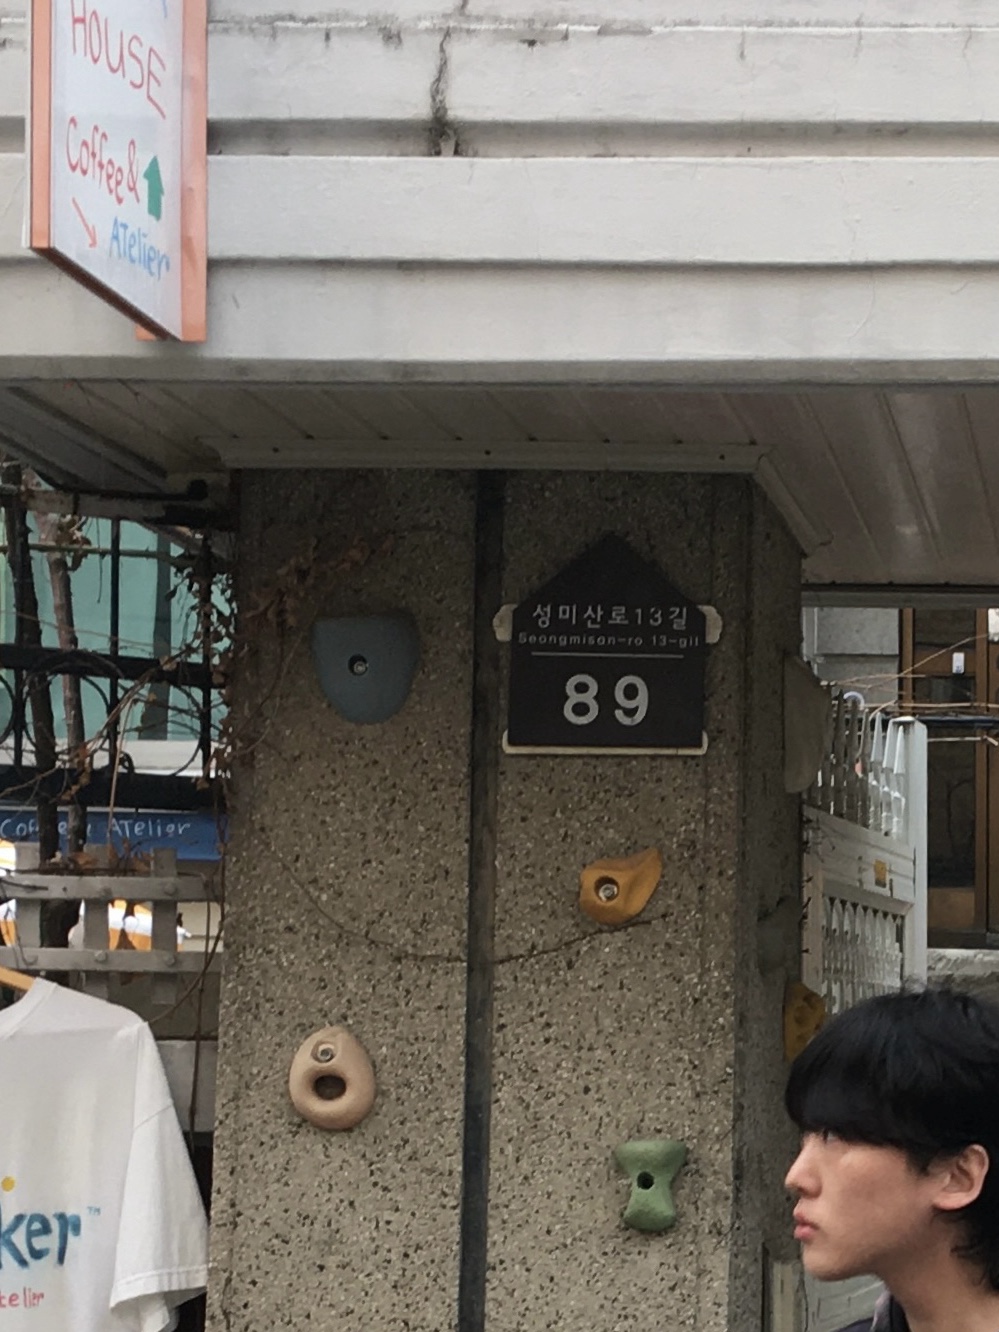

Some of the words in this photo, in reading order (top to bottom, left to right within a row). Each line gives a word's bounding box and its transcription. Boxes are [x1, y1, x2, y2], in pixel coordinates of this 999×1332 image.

[70, 0, 167, 120] HOUSE
[532, 603, 688, 631] 성미산로13길
[518, 631, 643, 647] Seongmisan-ro
[652, 633, 699, 649] 13-gil
[563, 673, 649, 726] 89
